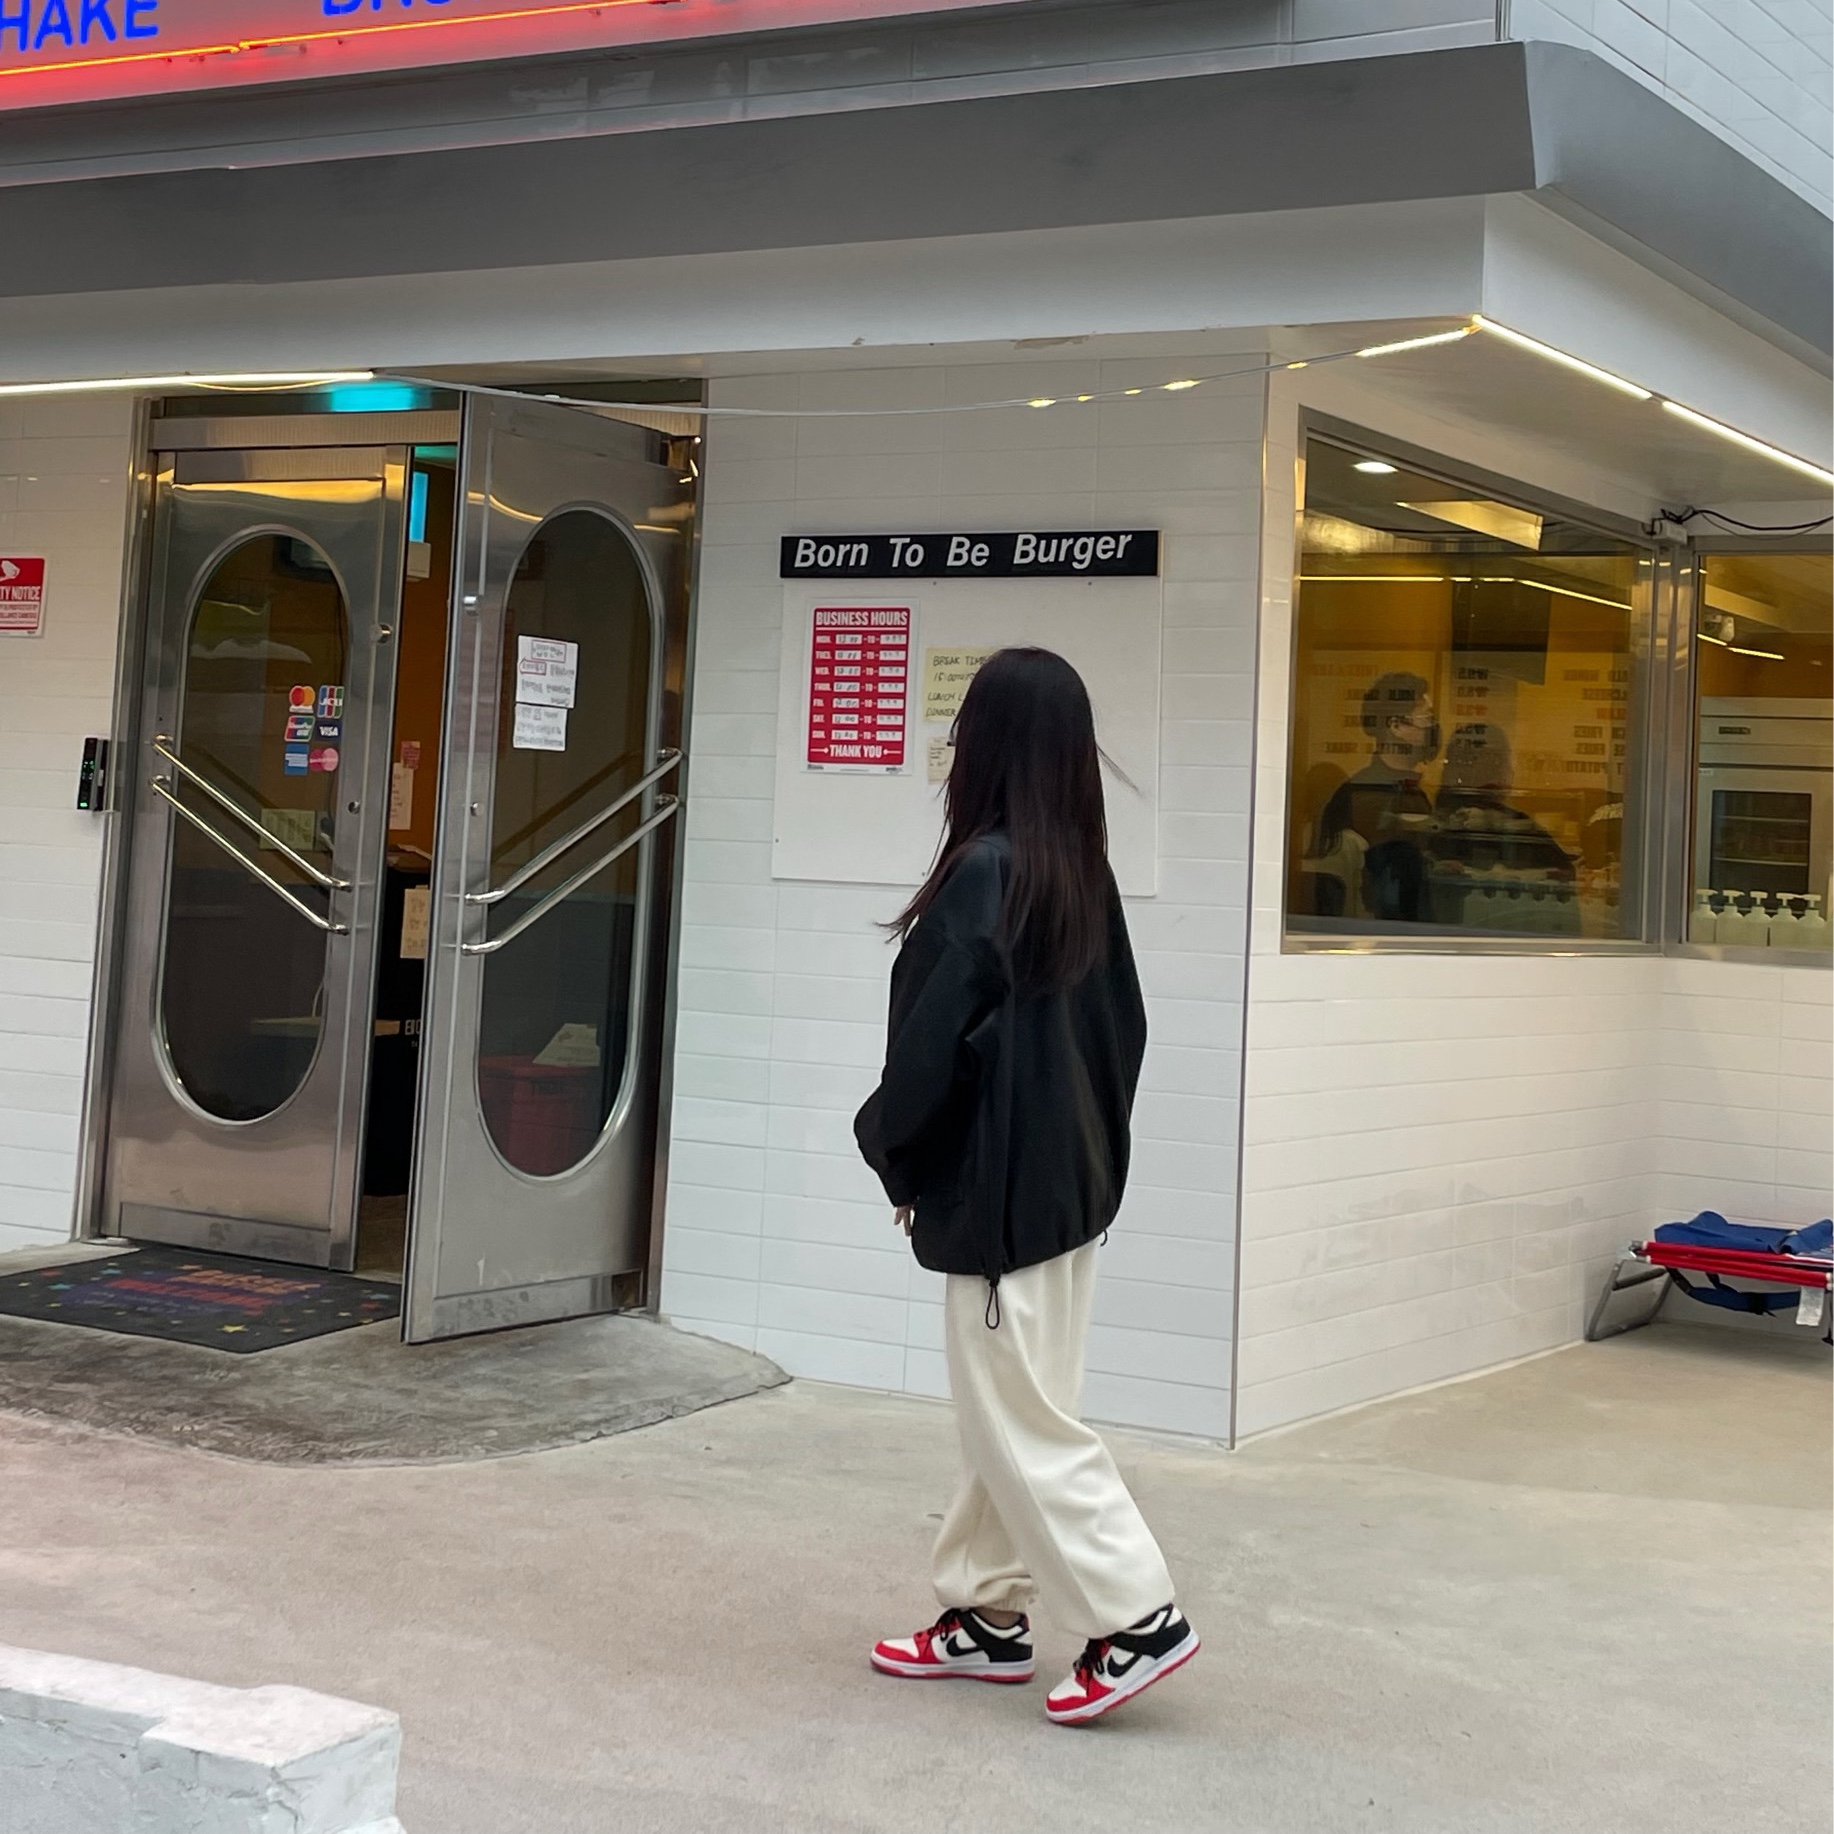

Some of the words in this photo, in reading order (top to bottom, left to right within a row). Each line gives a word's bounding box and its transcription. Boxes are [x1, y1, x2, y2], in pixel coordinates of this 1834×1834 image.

[0, 0, 159, 51] HAKE
[794, 538, 869, 567] Born
[889, 537, 925, 567] To
[946, 536, 990, 567] Be
[1013, 533, 1133, 569] Burger
[12, 586, 40, 600] NOTICE
[816, 611, 869, 626] BUSINESS
[871, 611, 908, 626] HOURS
[933, 656, 960, 666] BREAK
[926, 708, 957, 717] DINNER
[320, 727, 339, 736] VISA
[829, 744, 861, 758] THANK
[863, 745, 883, 758] YOU
